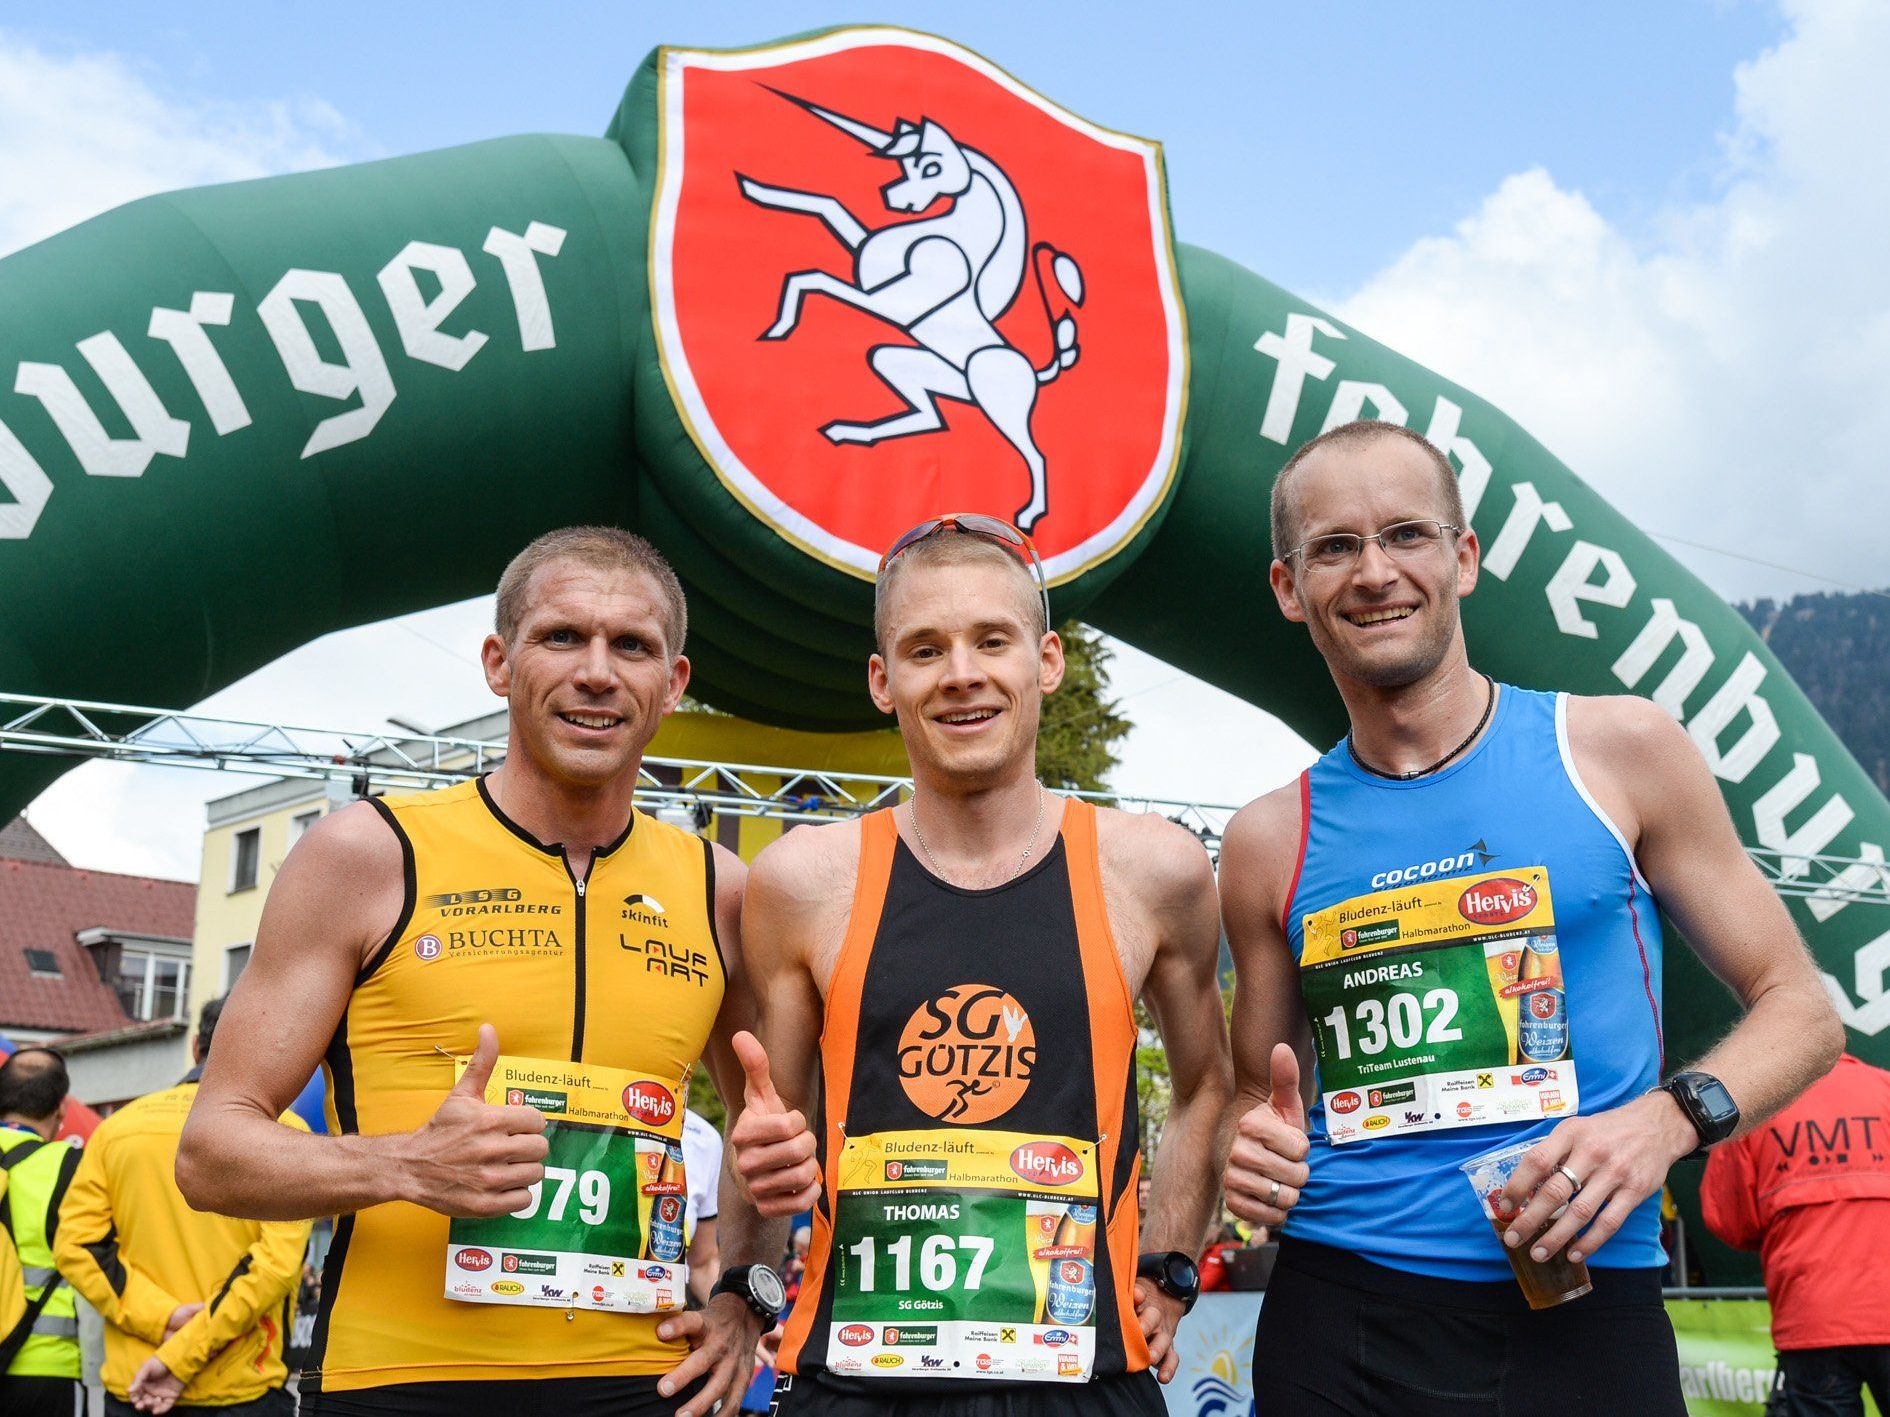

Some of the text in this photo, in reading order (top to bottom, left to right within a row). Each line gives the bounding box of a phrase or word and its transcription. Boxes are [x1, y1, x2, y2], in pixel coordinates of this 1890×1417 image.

[1371, 852, 1474, 888] cocoon
[1339, 896, 1422, 924] Bludenz-läuft
[1465, 887, 1532, 914] Hervis
[440, 904, 562, 917] VORARLBERG
[621, 909, 668, 928] skinfit
[448, 929, 562, 950] BUCHTA
[1402, 922, 1471, 939] Halbmarathon
[1343, 961, 1424, 989] ANDREAS
[919, 990, 1003, 1041] SG
[1324, 988, 1463, 1060] 1302
[898, 1043, 1038, 1080] GÖTZIS
[1357, 1054, 1436, 1074] TriTeam Lustenau
[505, 1069, 591, 1088] Bludenz-läuft
[628, 1087, 673, 1117] Hervis
[1333, 1096, 1359, 1110] Hervis
[568, 1107, 629, 1122] Halbmarathon
[1769, 1116, 1882, 1157] VMT
[885, 1141, 975, 1154] Bludenz-läuft
[1018, 1148, 1079, 1178] Hervis
[949, 1173, 1018, 1183] Halbmarathon
[883, 1204, 960, 1221] THOMAS
[458, 1252, 491, 1267] Hervis
[850, 1234, 995, 1292] 1167
[500, 1284, 521, 1292] RAUCH
[898, 1300, 944, 1310] SG Götzis
[841, 1328, 872, 1343] Hervis
[879, 1356, 901, 1364] RAUCH
